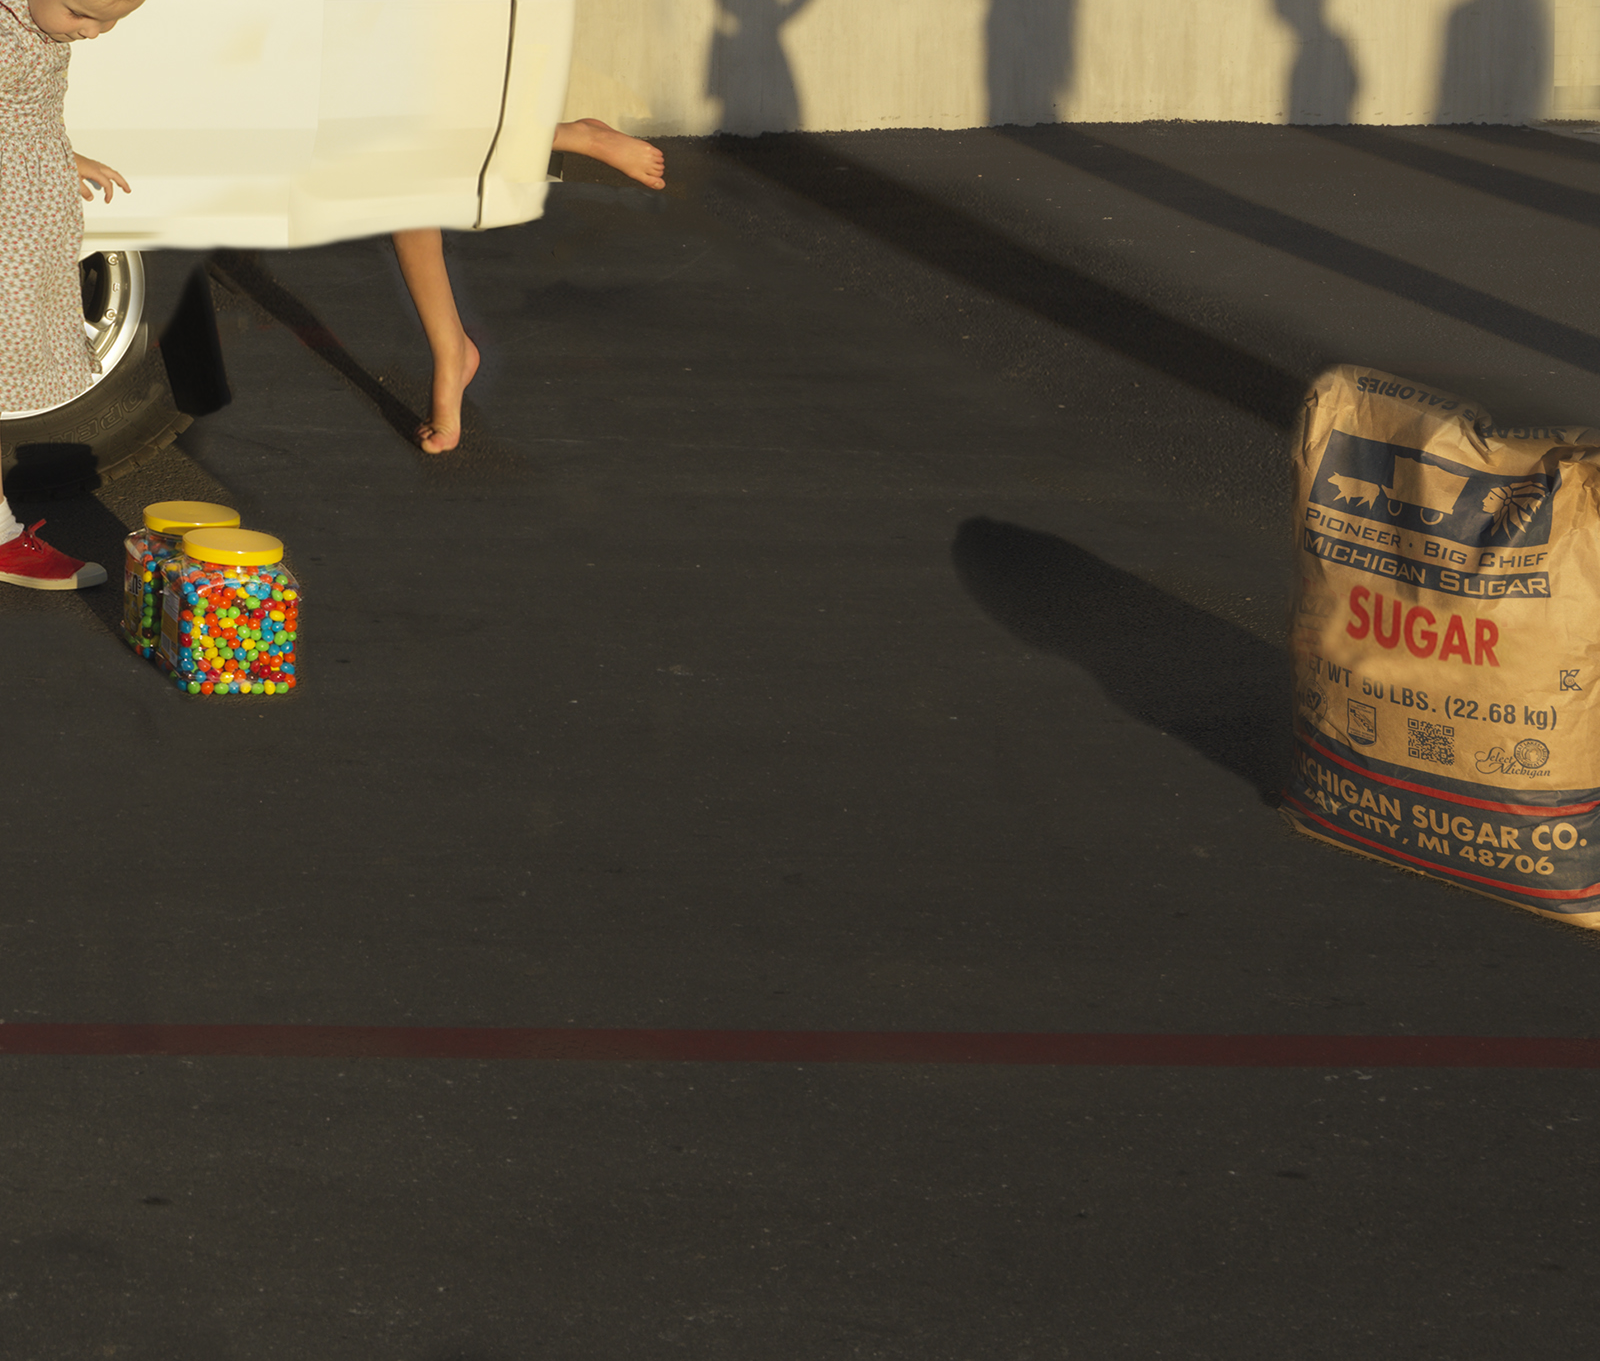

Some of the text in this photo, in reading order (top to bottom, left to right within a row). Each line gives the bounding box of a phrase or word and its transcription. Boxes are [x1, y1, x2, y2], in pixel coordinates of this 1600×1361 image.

[1356, 376, 1460, 411] CALORIES
[1305, 507, 1548, 568] PIONEER BIG CHIEF
[1305, 531, 1549, 596] MICHIGAN SUGAR
[1345, 585, 1500, 668] SUGAR
[1307, 652, 1558, 731] ET WT 50 LBS. (22.68 kg)
[1474, 746, 1513, 764] Select
[1476, 761, 1551, 779] Michigan
[1299, 750, 1587, 852] ICHIGAN SUGAR CO.
[1349, 809, 1409, 845] CITY,
[1418, 832, 1450, 855] MI
[1459, 846, 1555, 875] 48706
